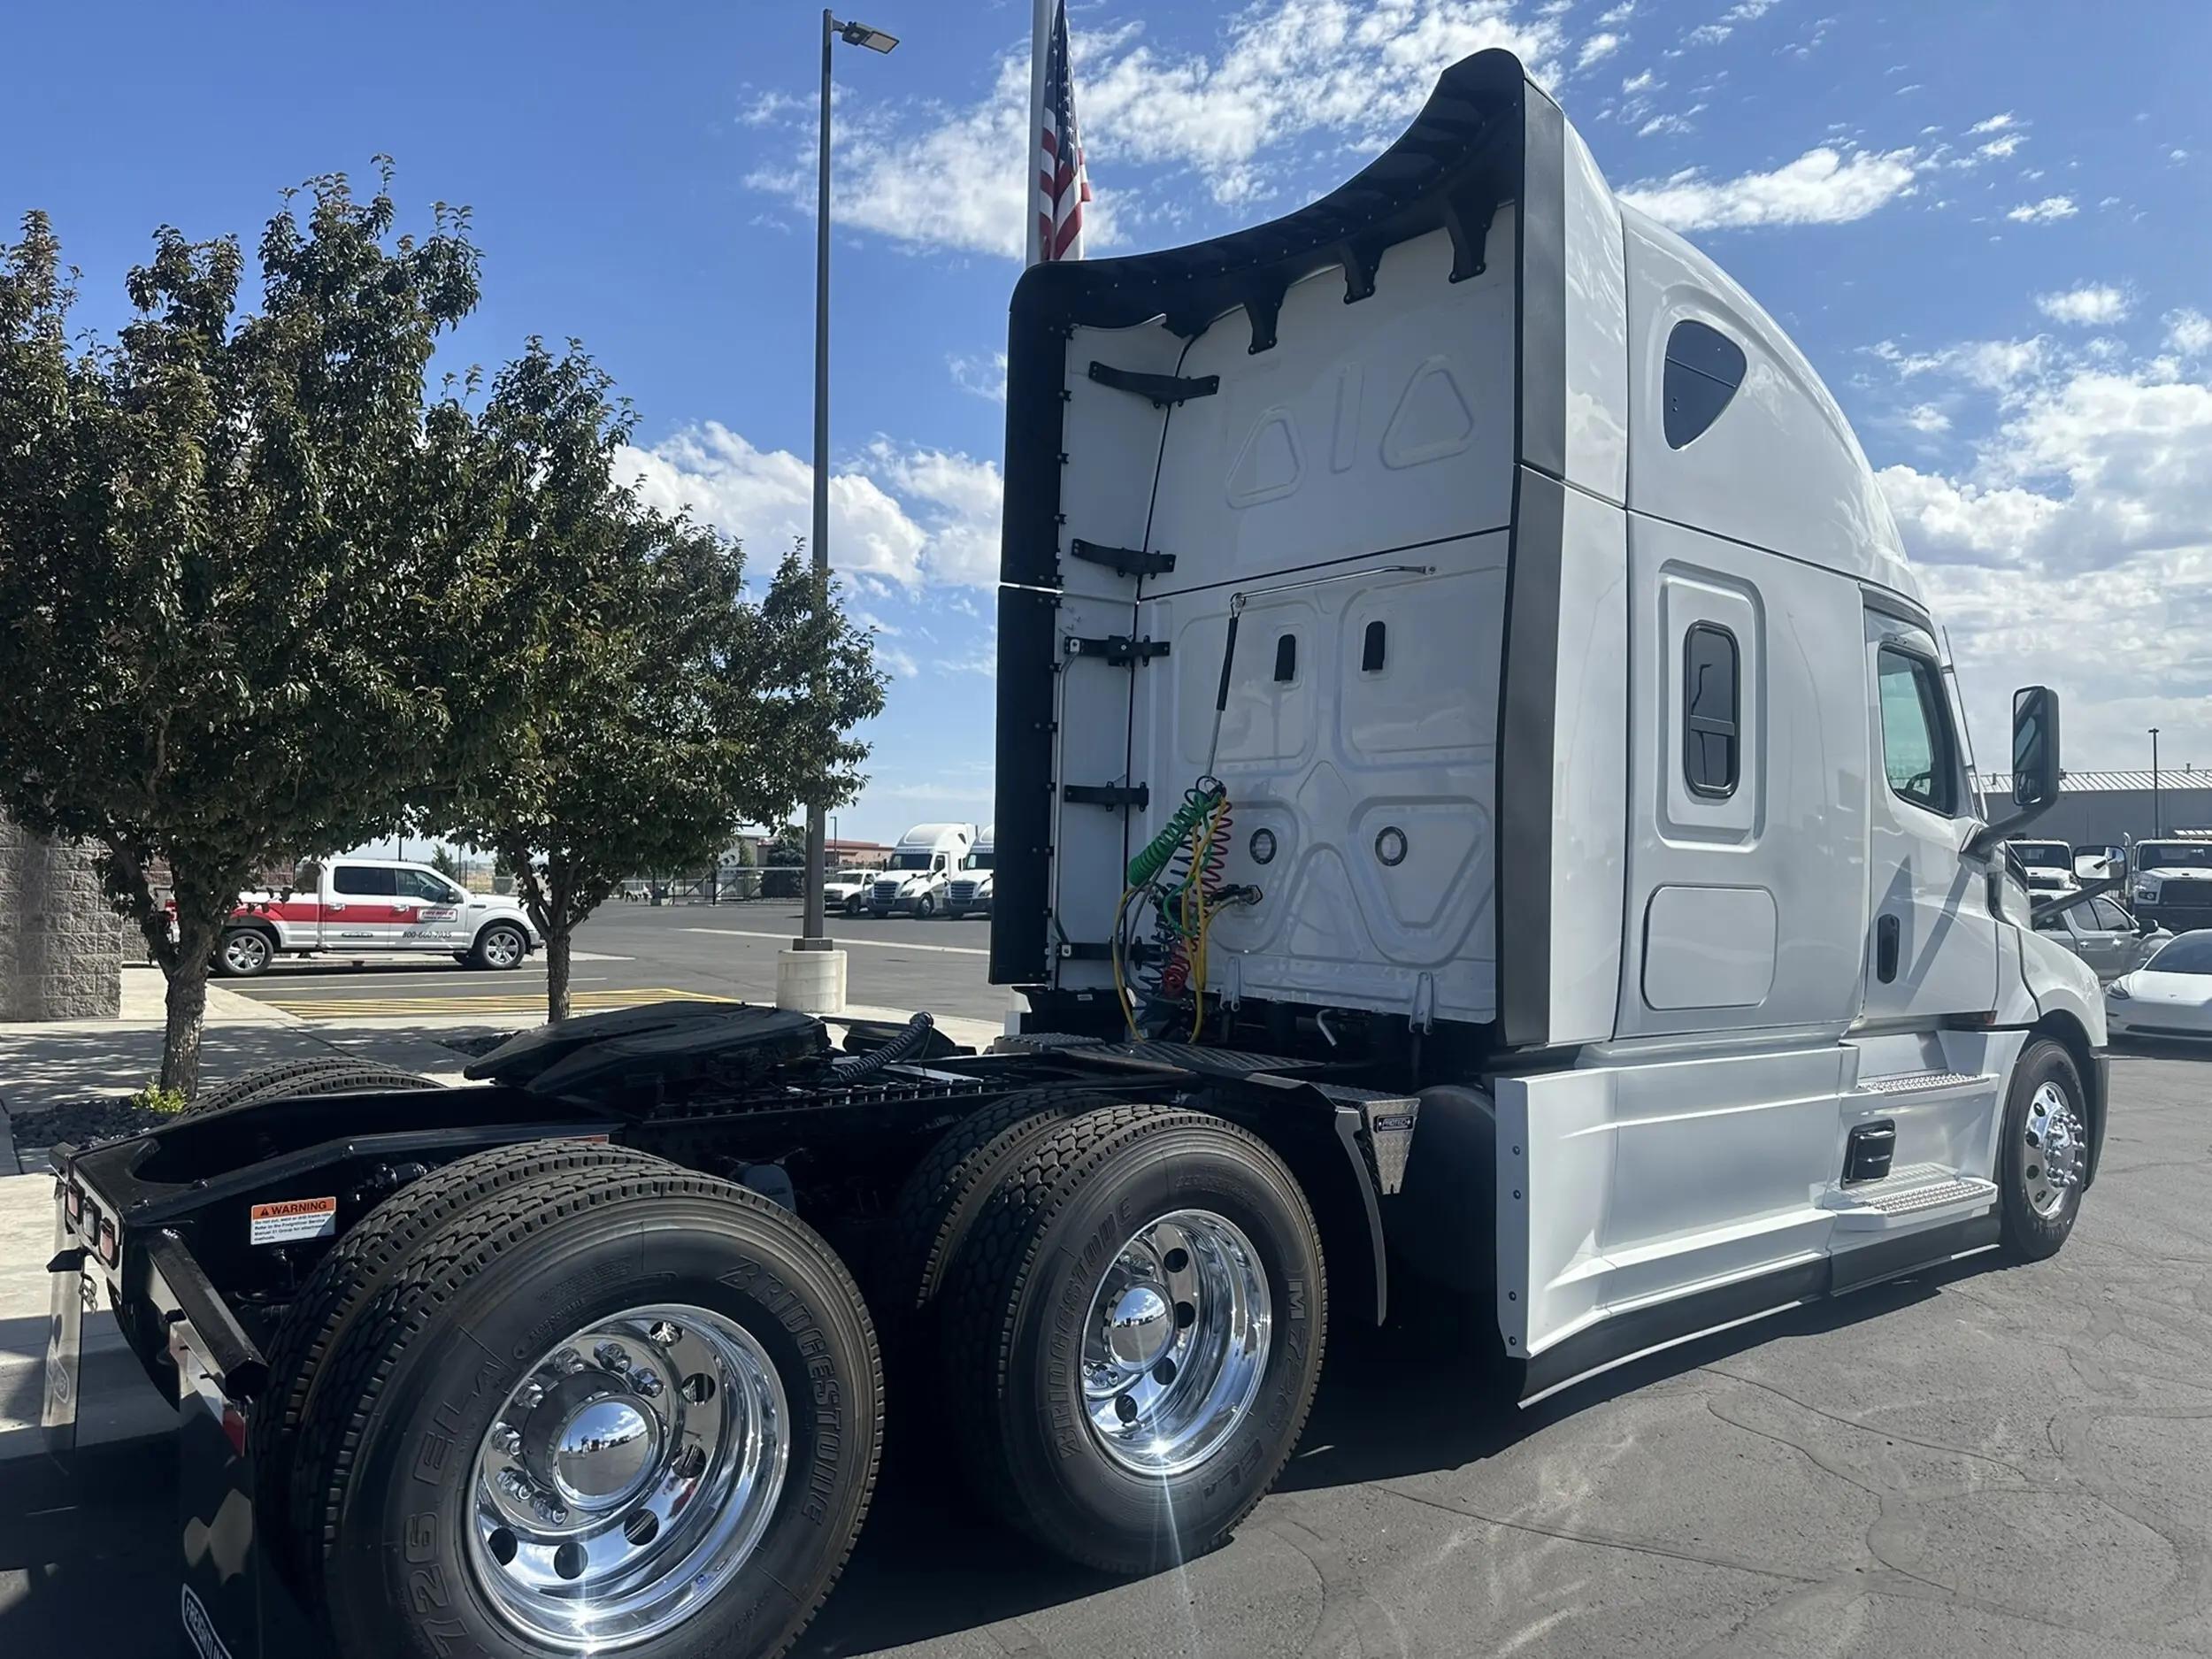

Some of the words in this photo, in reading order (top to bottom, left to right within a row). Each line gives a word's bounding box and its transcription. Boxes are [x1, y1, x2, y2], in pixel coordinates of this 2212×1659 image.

[272, 1201, 326, 1214] WARNING
[715, 1253, 842, 1526] BRIDGESTONE
[1048, 1197, 1133, 1461] BRIDGESTONE
[412, 1359, 501, 1486] ELA
[398, 1511, 489, 1659] 726
